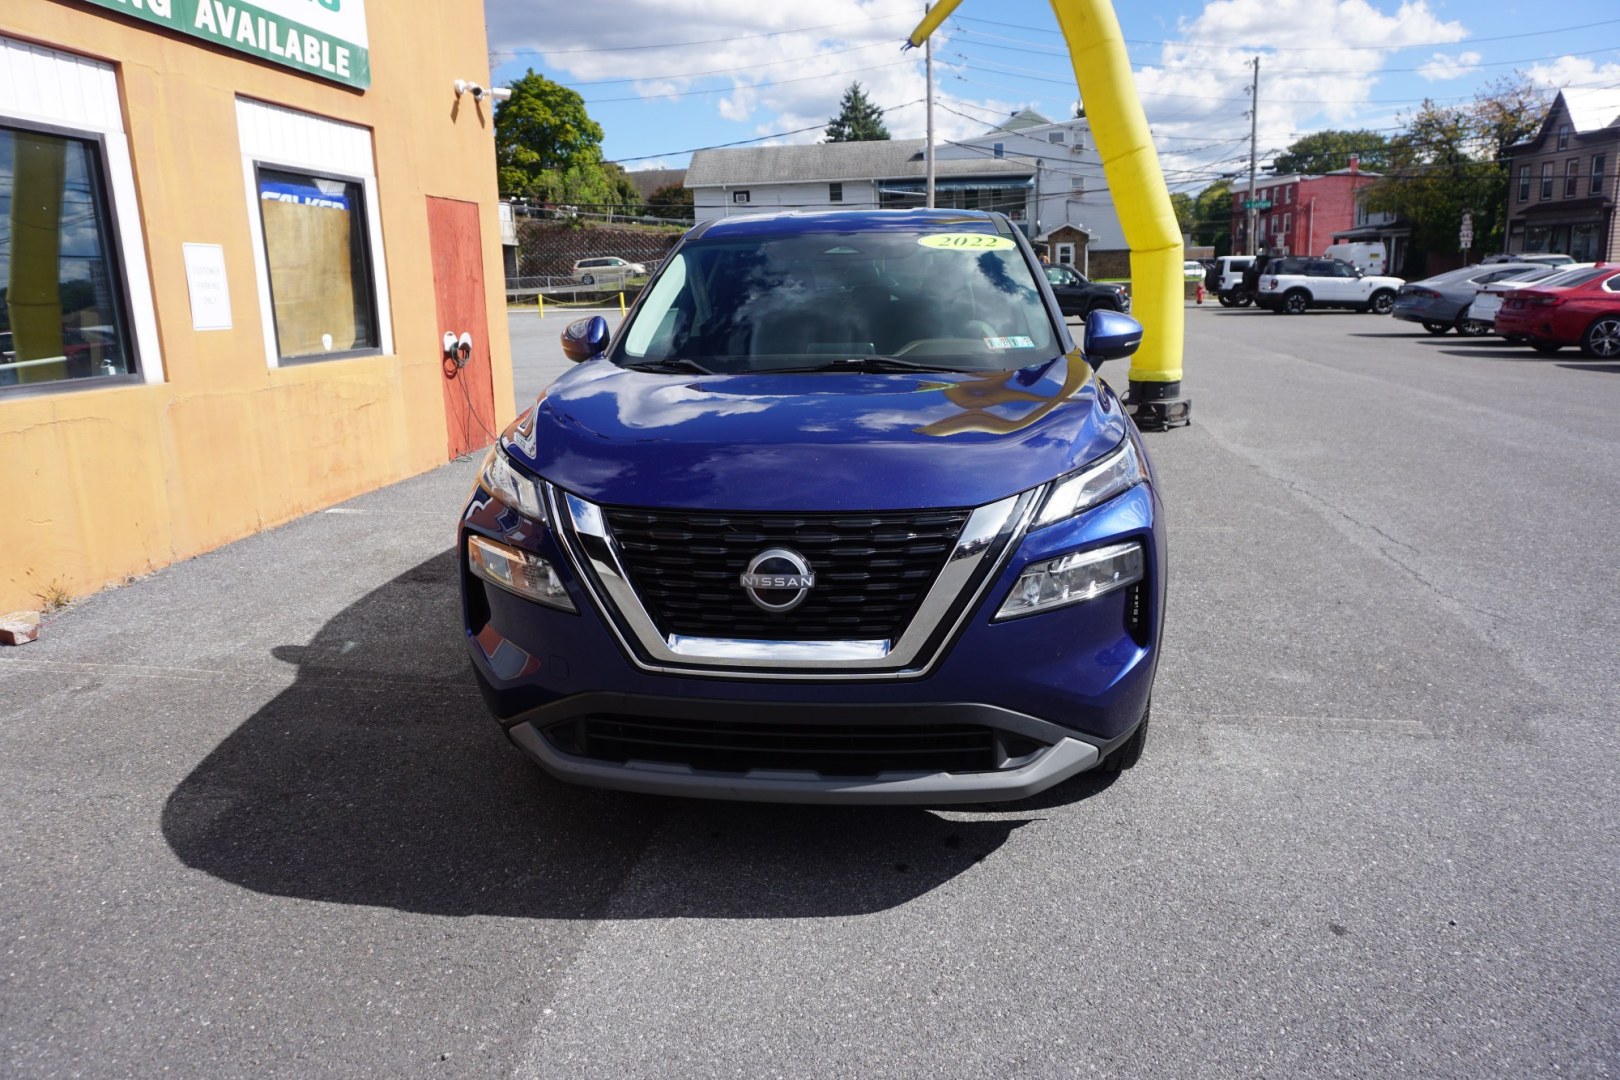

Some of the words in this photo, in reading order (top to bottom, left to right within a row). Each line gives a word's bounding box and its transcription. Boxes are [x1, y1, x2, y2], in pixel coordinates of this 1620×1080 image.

[194, 1, 350, 78] AVAILABLE
[938, 237, 997, 247] 2022
[742, 576, 812, 586] NISSAN
